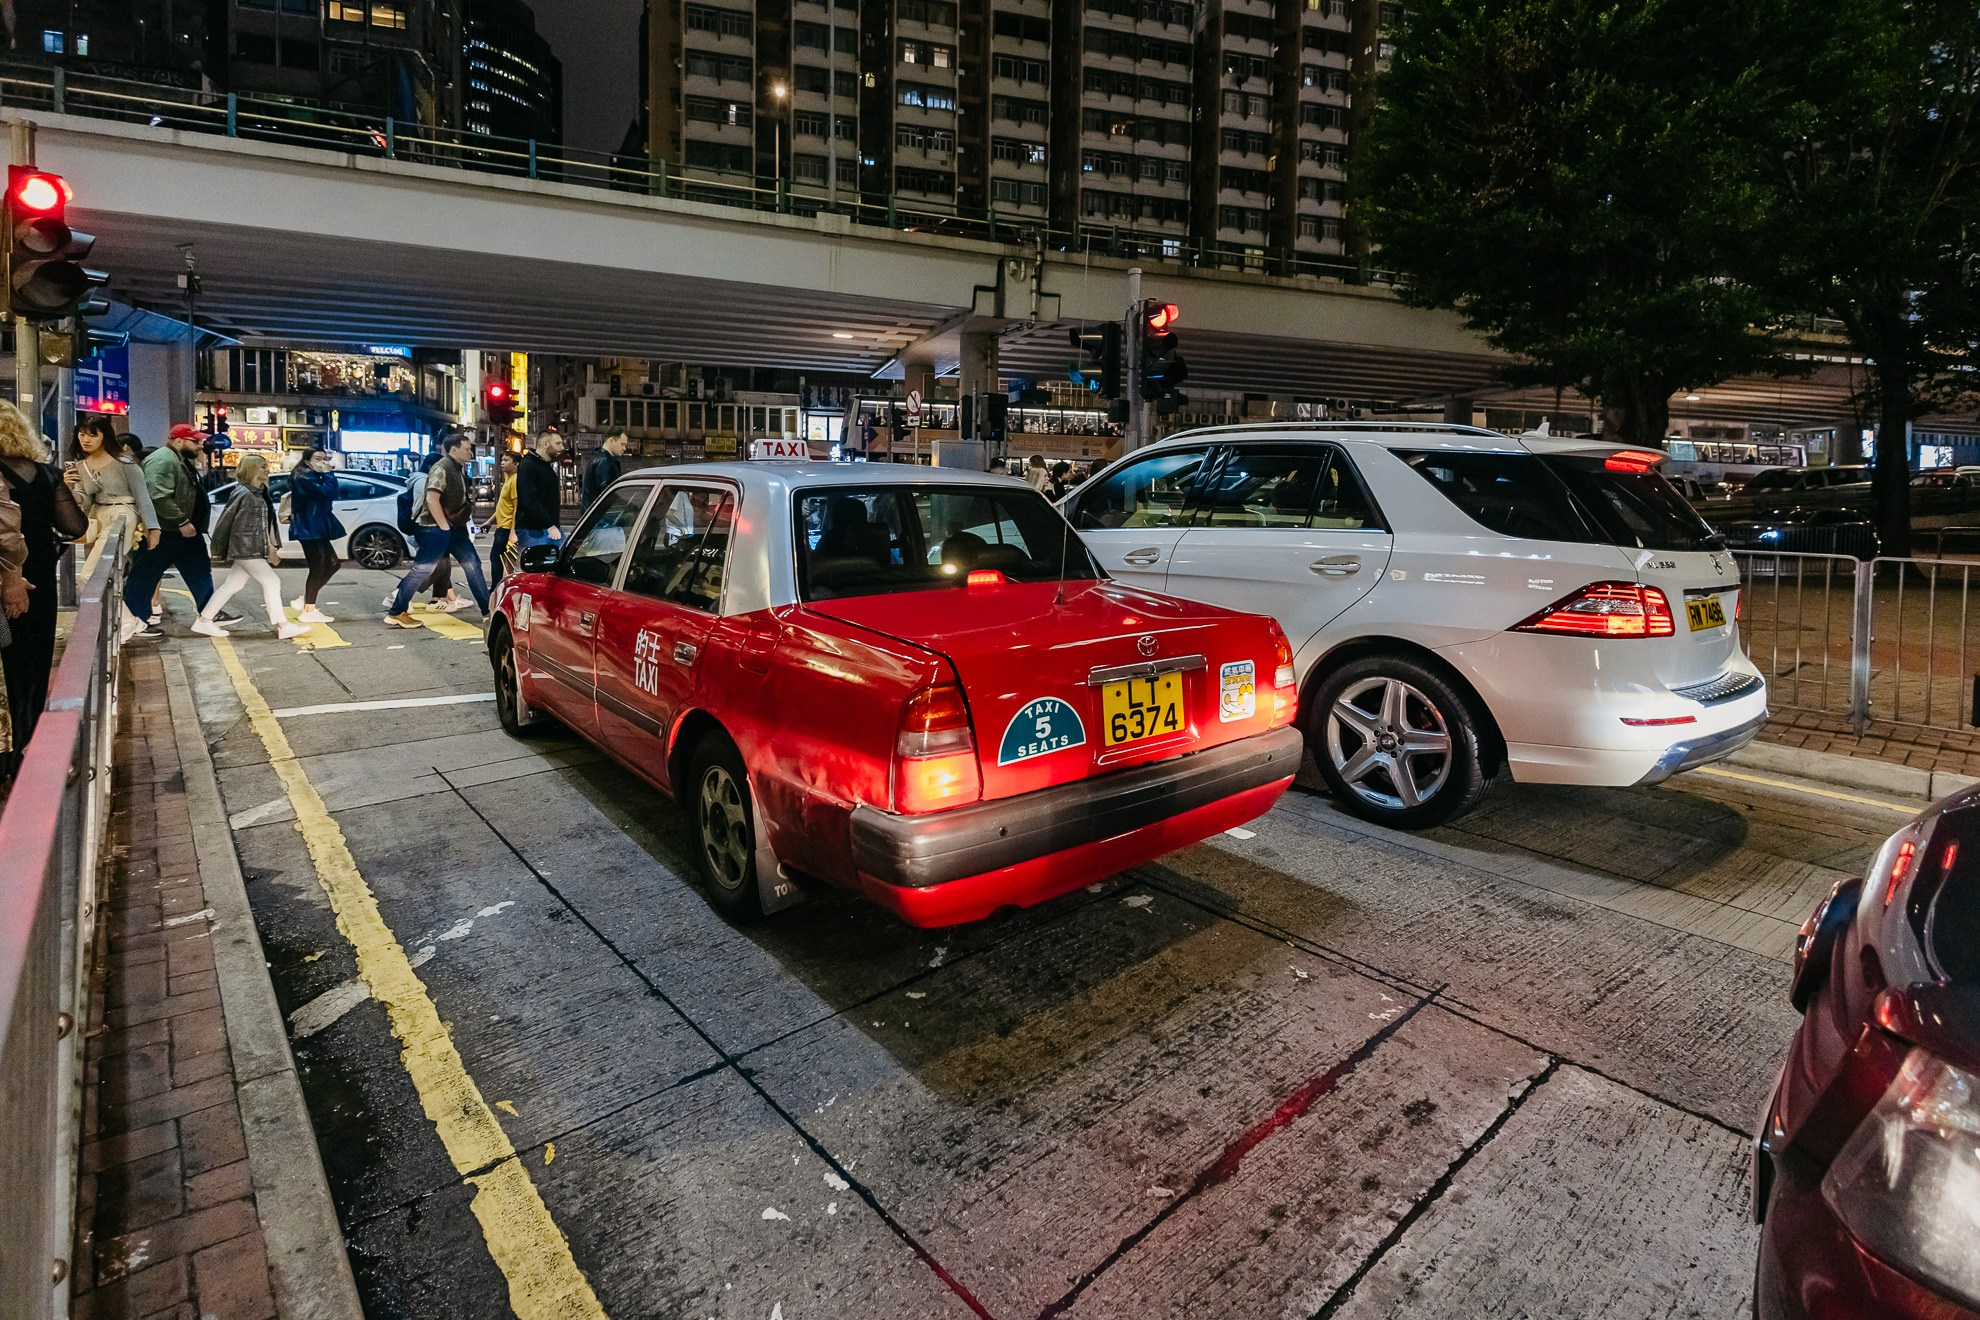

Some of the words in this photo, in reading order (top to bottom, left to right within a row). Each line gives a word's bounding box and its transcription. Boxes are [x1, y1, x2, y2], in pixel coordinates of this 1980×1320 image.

[763, 442, 806, 456] TAXI
[635, 628, 662, 664] 的士
[634, 656, 658, 696] TAXI
[1127, 676, 1160, 709] LT
[1025, 701, 1059, 719] TAXI
[1111, 702, 1178, 743] 6374
[1035, 716, 1052, 738] 5
[1017, 735, 1069, 757] SEATS
